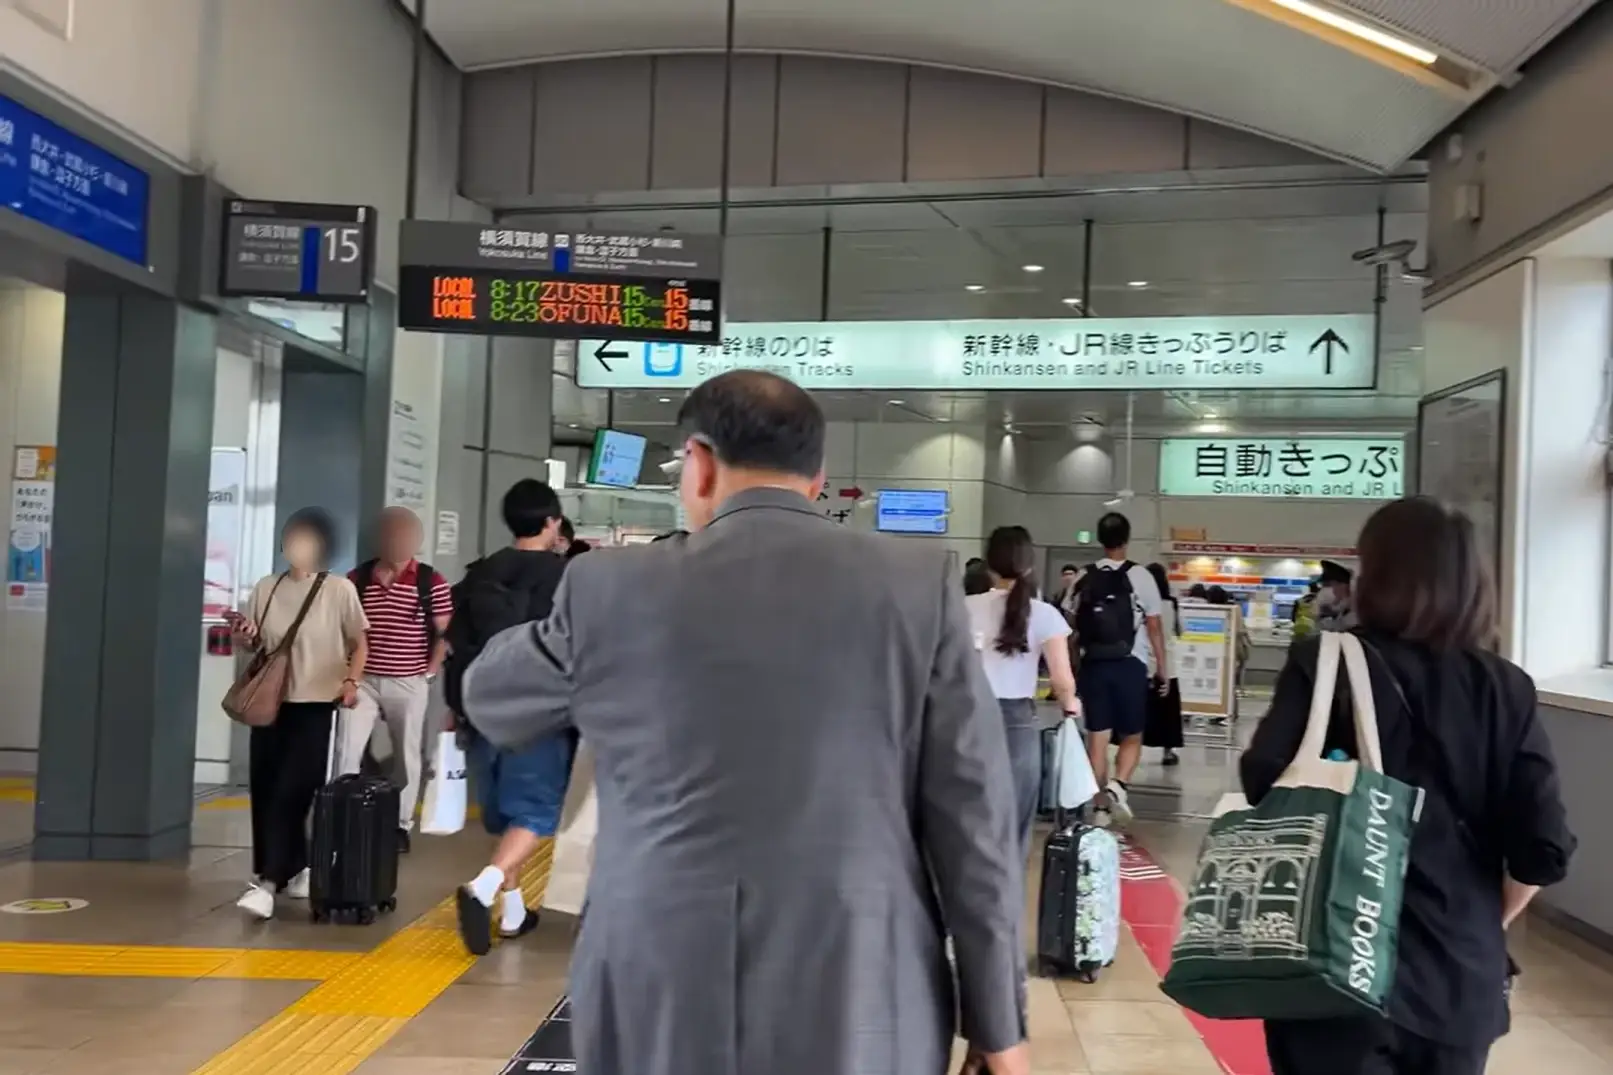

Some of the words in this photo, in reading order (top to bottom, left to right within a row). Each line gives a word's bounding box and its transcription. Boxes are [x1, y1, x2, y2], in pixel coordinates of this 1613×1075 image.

[324, 228, 360, 263] 15
[480, 229, 548, 248] 横須賀線
[490, 279, 539, 301] 8:17
[540, 281, 621, 305] ZUSHI
[623, 286, 645, 306] 15
[664, 288, 689, 309] 15
[490, 300, 539, 321] 8:23
[623, 307, 645, 327] 15
[664, 309, 689, 330] 15
[797, 361, 854, 376] Tracks
[962, 360, 1069, 376] Shinkansen
[1073, 360, 1108, 376] and
[1114, 360, 1139, 376] JR
[1146, 360, 1186, 375] Line
[1193, 358, 1264, 375] Tickets
[1196, 443, 1399, 478] 自動きっぷ
[1213, 480, 1313, 496] Shinkansen
[1321, 481, 1354, 496] and
[1362, 482, 1385, 497] JR
[1362, 788, 1393, 888] DAUNT
[1348, 895, 1382, 993] BOOKS
